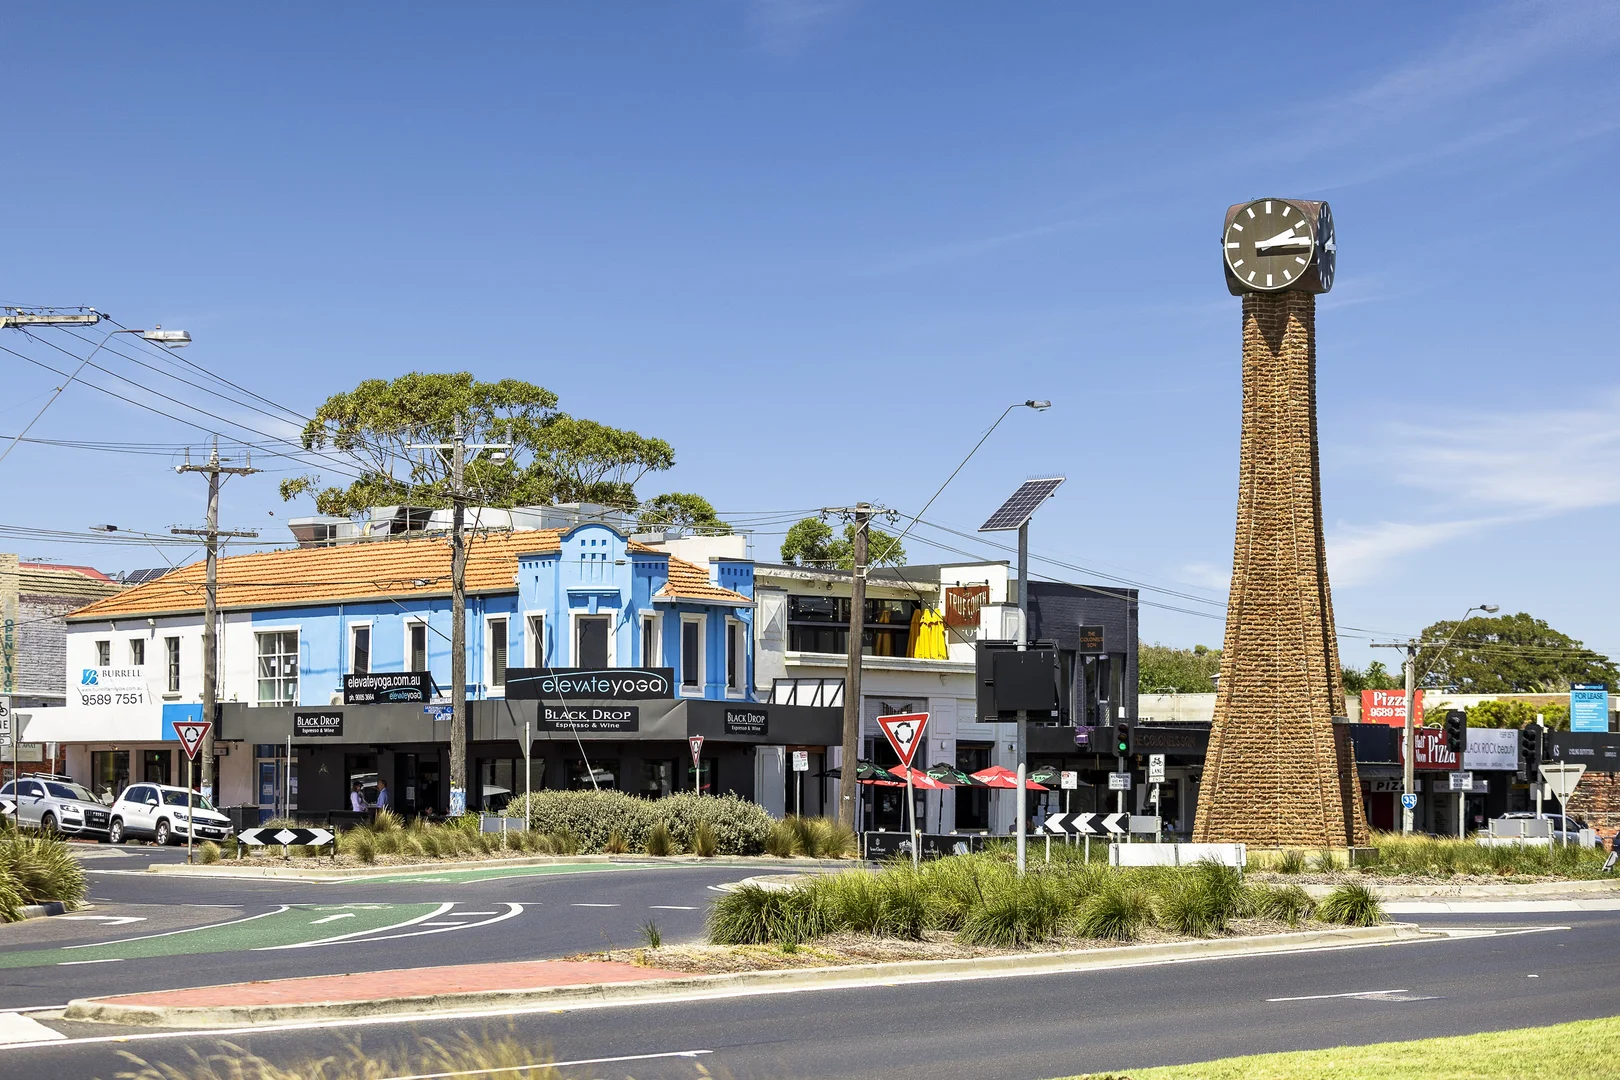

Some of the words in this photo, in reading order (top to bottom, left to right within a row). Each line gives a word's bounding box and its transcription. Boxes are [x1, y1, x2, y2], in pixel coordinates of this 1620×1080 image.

[4, 619, 14, 650] OPEN
[102, 669, 142, 677] BURRELL
[348, 675, 421, 689] elevateyoga.com.au
[542, 676, 662, 696] elevateyoga
[82, 694, 112, 705] 9589
[115, 693, 143, 704] 7551
[1574, 692, 1587, 700] FOR
[1587, 692, 1603, 700] LEASE
[544, 708, 587, 720] BLACK
[592, 709, 632, 720] DROP
[727, 711, 747, 723] BLACK
[747, 712, 766, 723] DROP
[1370, 707, 1394, 717] 9589
[297, 716, 319, 726] BLACK
[320, 715, 340, 725] DROP
[1414, 735, 1426, 749] Half
[1427, 734, 1456, 763] Pizza
[1464, 742, 1480, 754] LACK
[1482, 742, 1497, 754] ROCK
[1497, 744, 1515, 756] beauty
[1415, 749, 1427, 762] Moon
